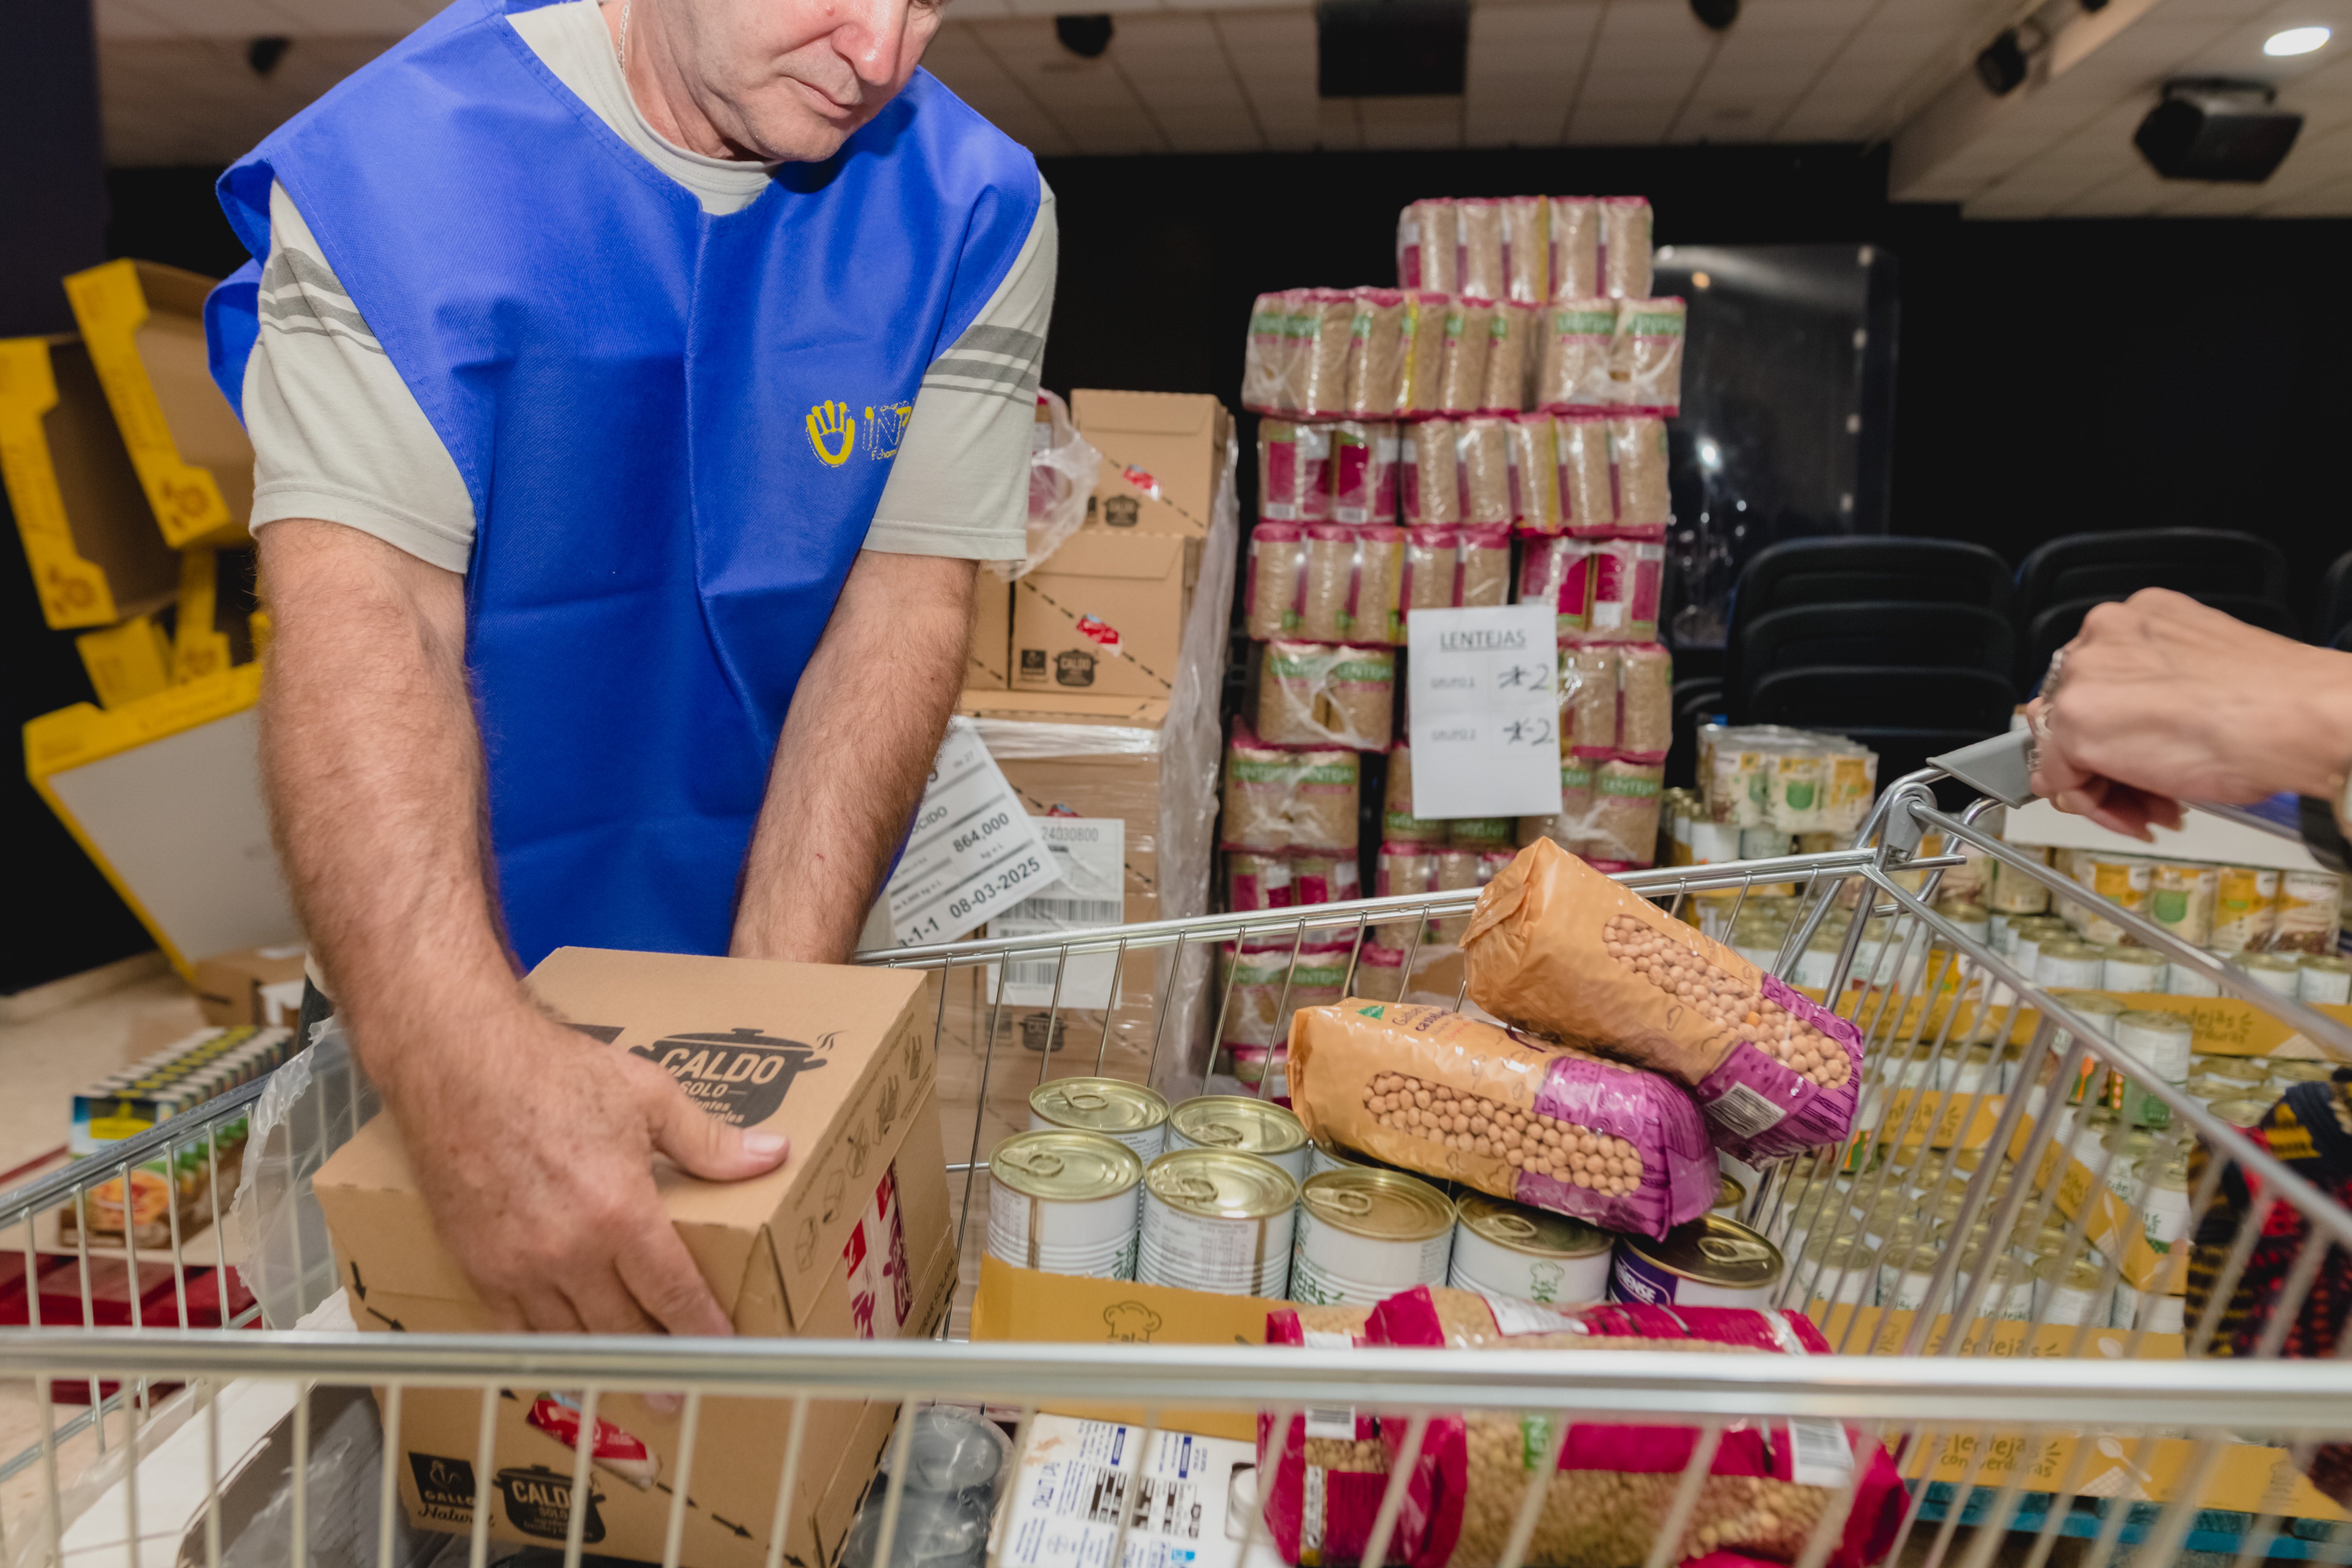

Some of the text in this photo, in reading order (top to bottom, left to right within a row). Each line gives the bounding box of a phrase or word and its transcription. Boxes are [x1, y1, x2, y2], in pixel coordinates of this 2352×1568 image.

[1440, 628, 1526, 647] LENTEJAS
[952, 812, 1009, 853] 864,000
[949, 856, 1041, 919] 08-03-2025
[659, 1047, 785, 1085] CALDO
[511, 1479, 574, 1508] CALD
